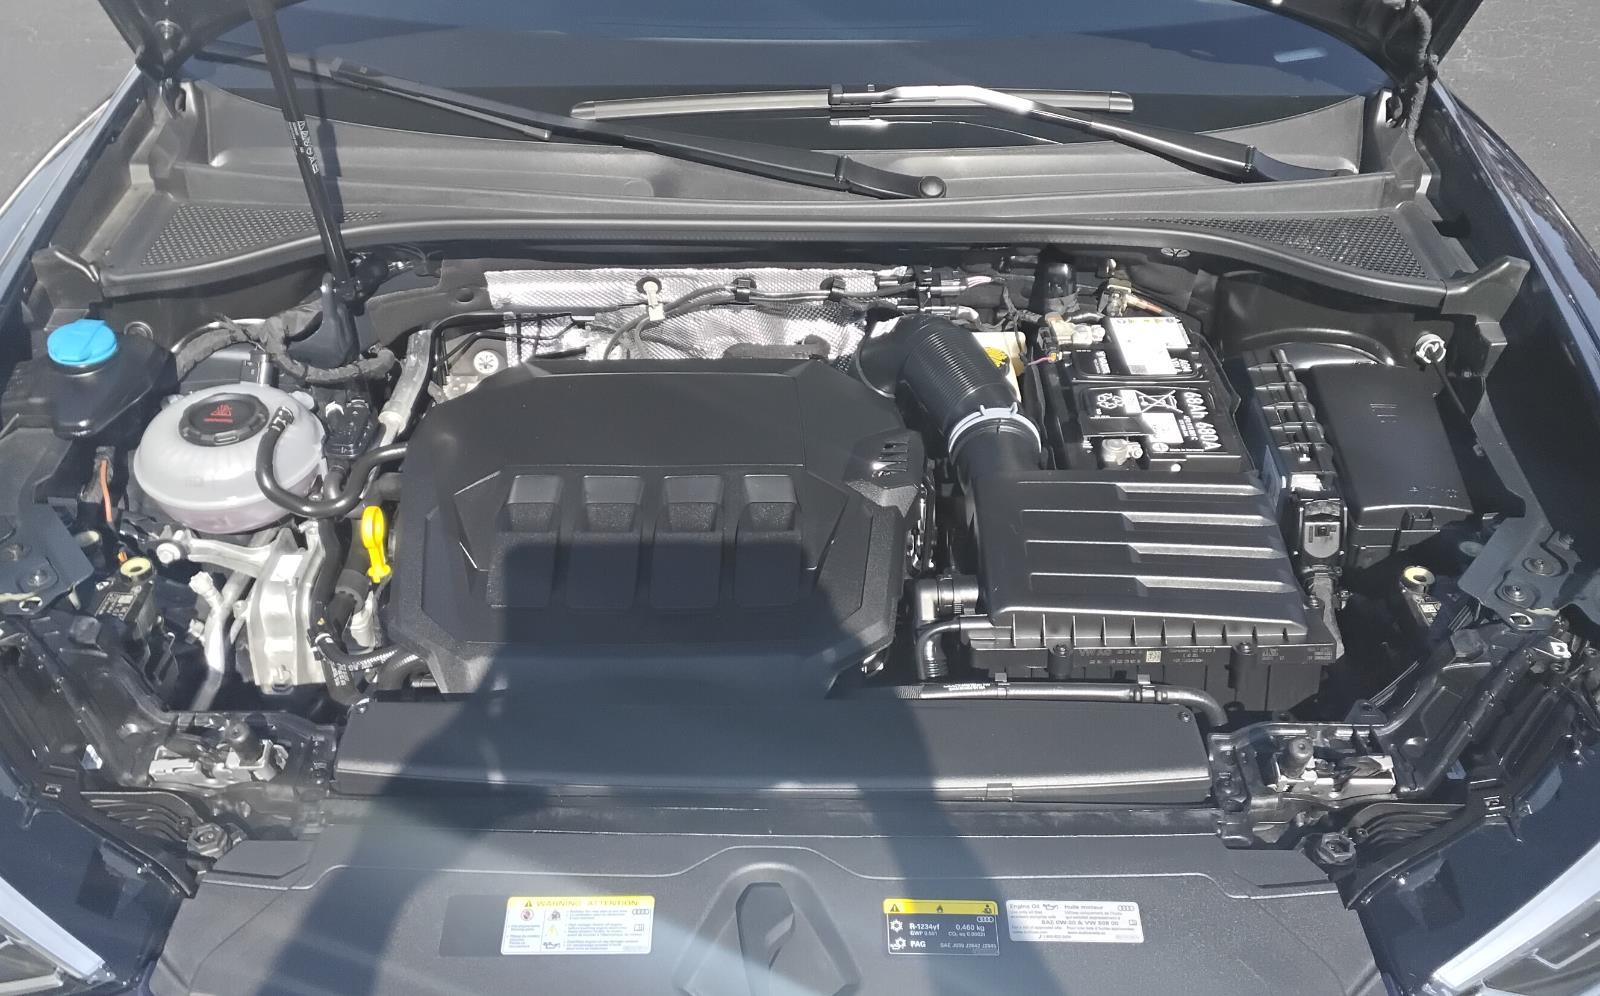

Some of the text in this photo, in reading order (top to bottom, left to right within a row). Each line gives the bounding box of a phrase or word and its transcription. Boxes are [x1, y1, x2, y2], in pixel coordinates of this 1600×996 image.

[1184, 392, 1209, 419] 68Ah
[1195, 421, 1222, 450] 680A
[909, 923, 940, 931] R-1234yf
